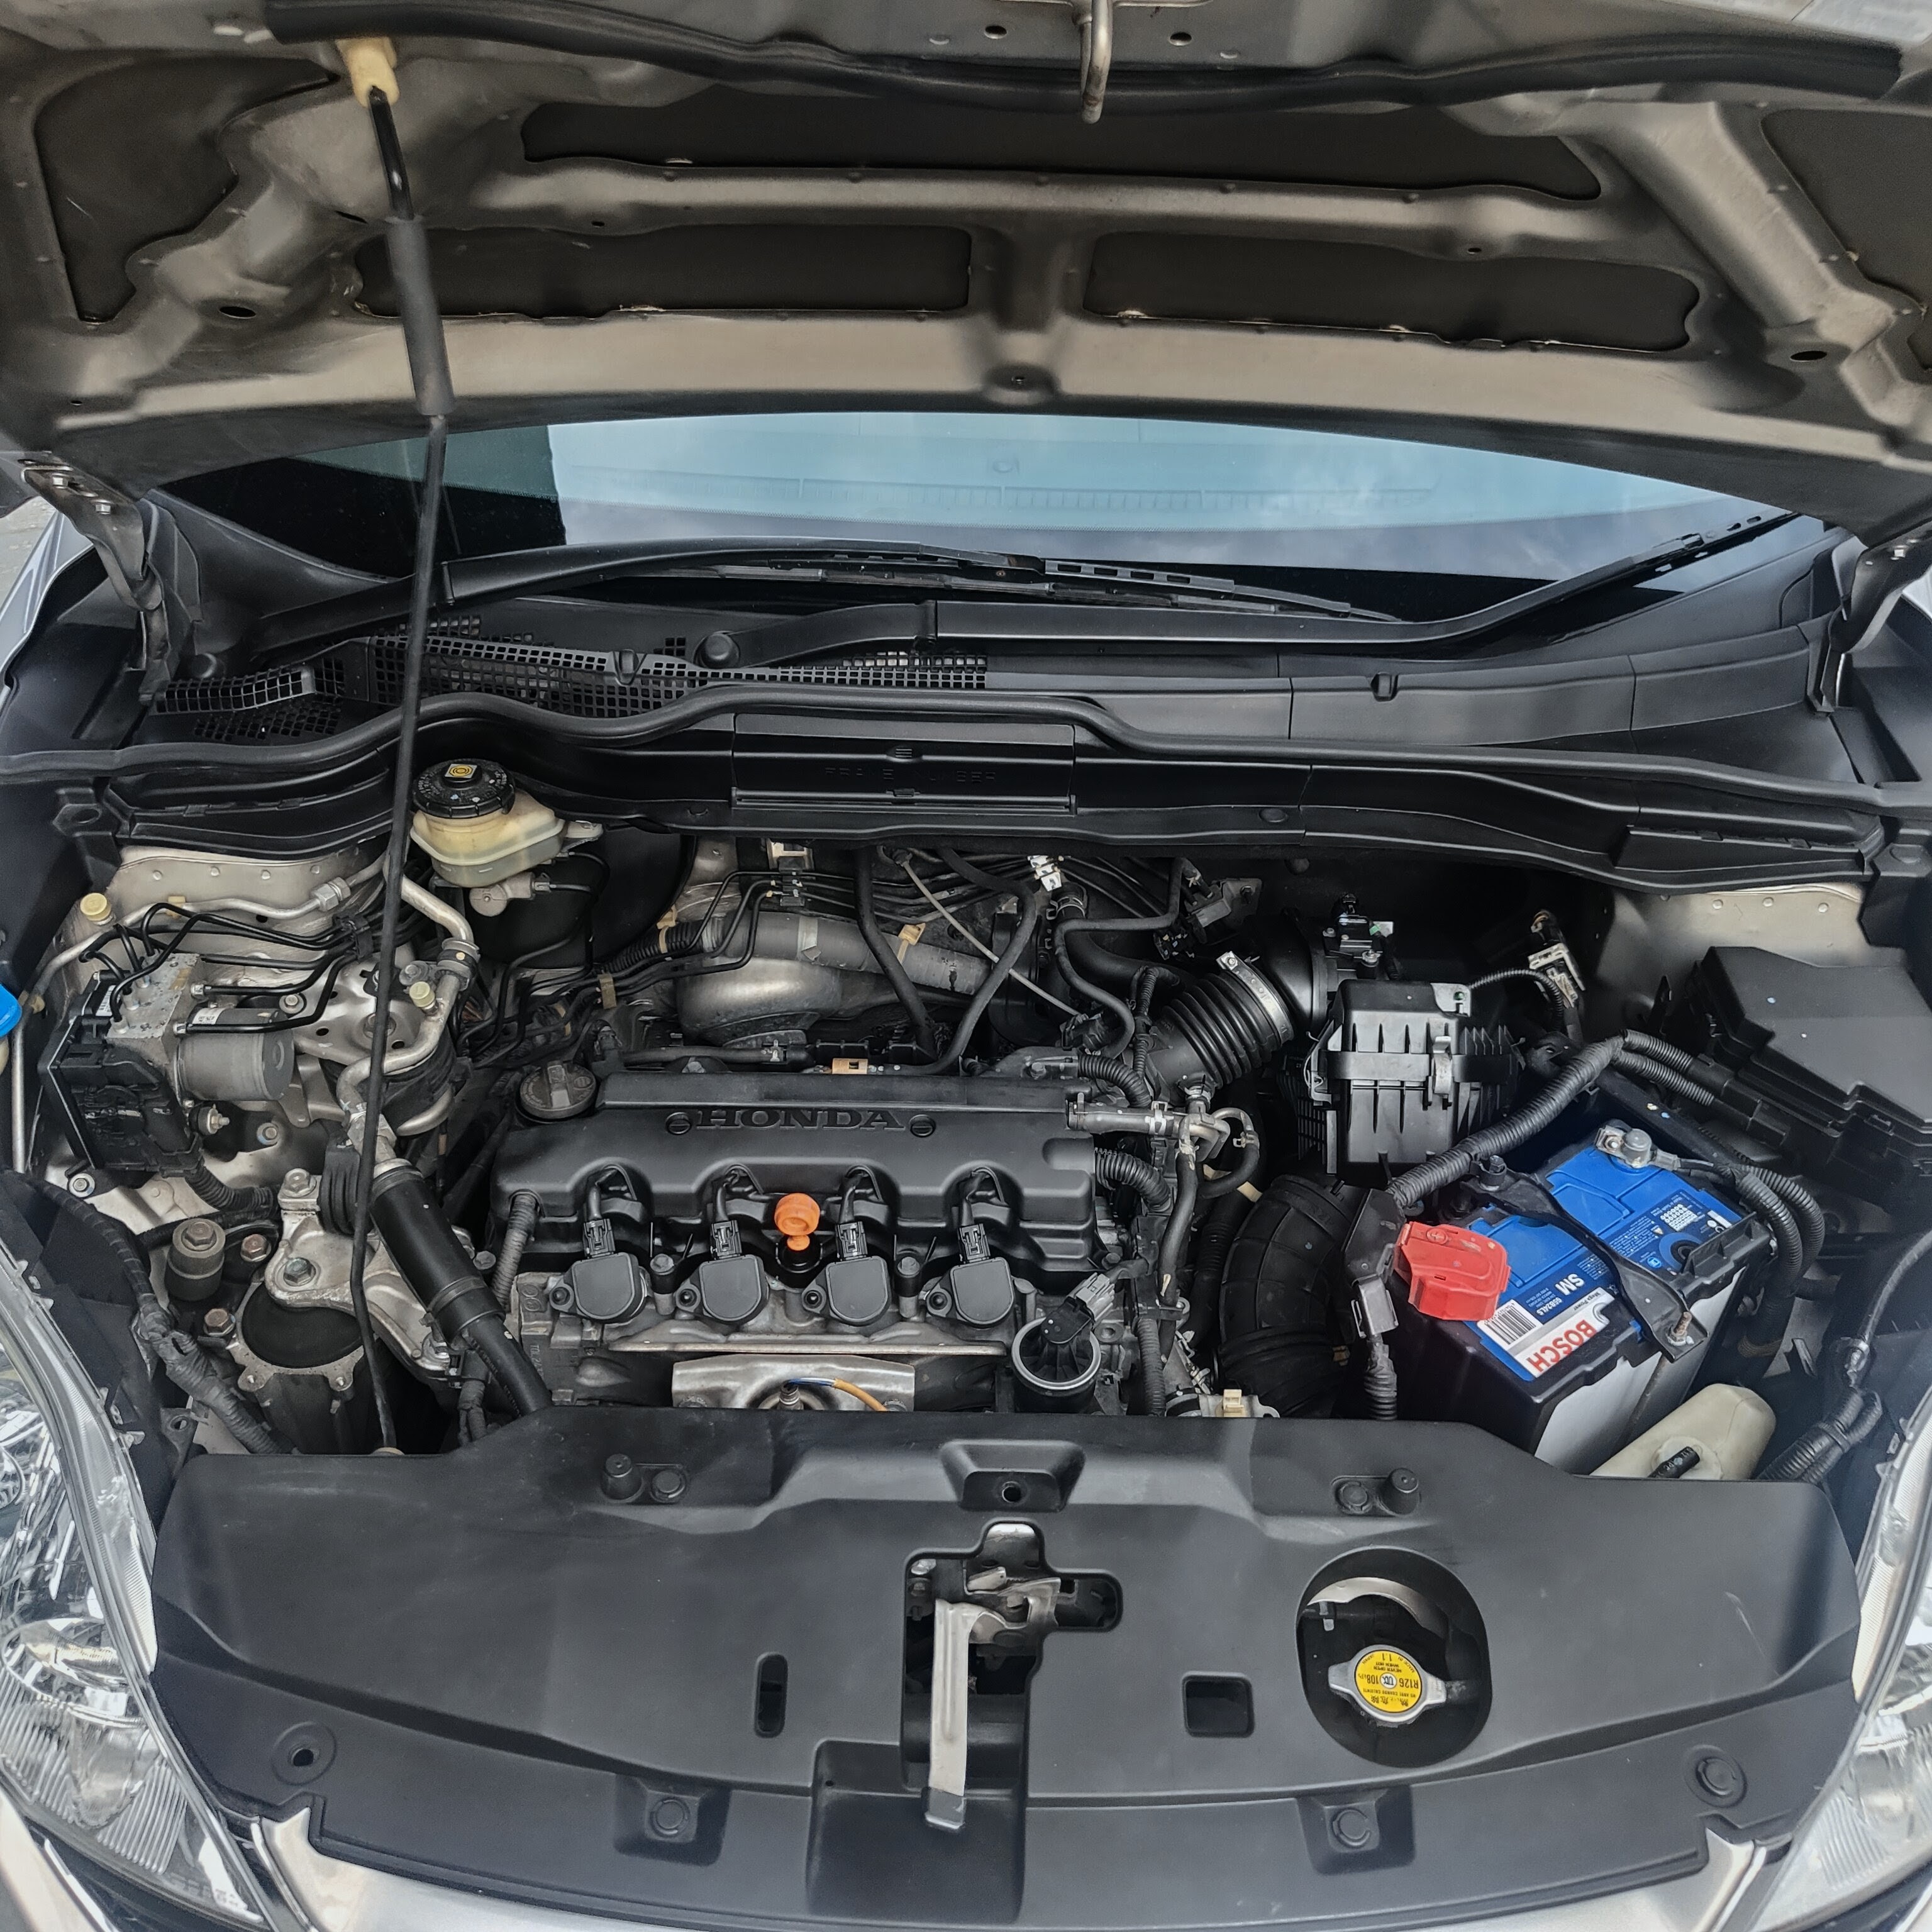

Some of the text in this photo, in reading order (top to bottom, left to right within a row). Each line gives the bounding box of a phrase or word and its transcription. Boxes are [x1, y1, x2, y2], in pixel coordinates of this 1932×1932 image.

[696, 1109, 906, 1130] HONDA
[1555, 1274, 1584, 1296] SM
[1536, 1297, 1562, 1316] 65B24LS
[1526, 1319, 1597, 1373] BOSCH
[1399, 1677, 1419, 1689] R126
